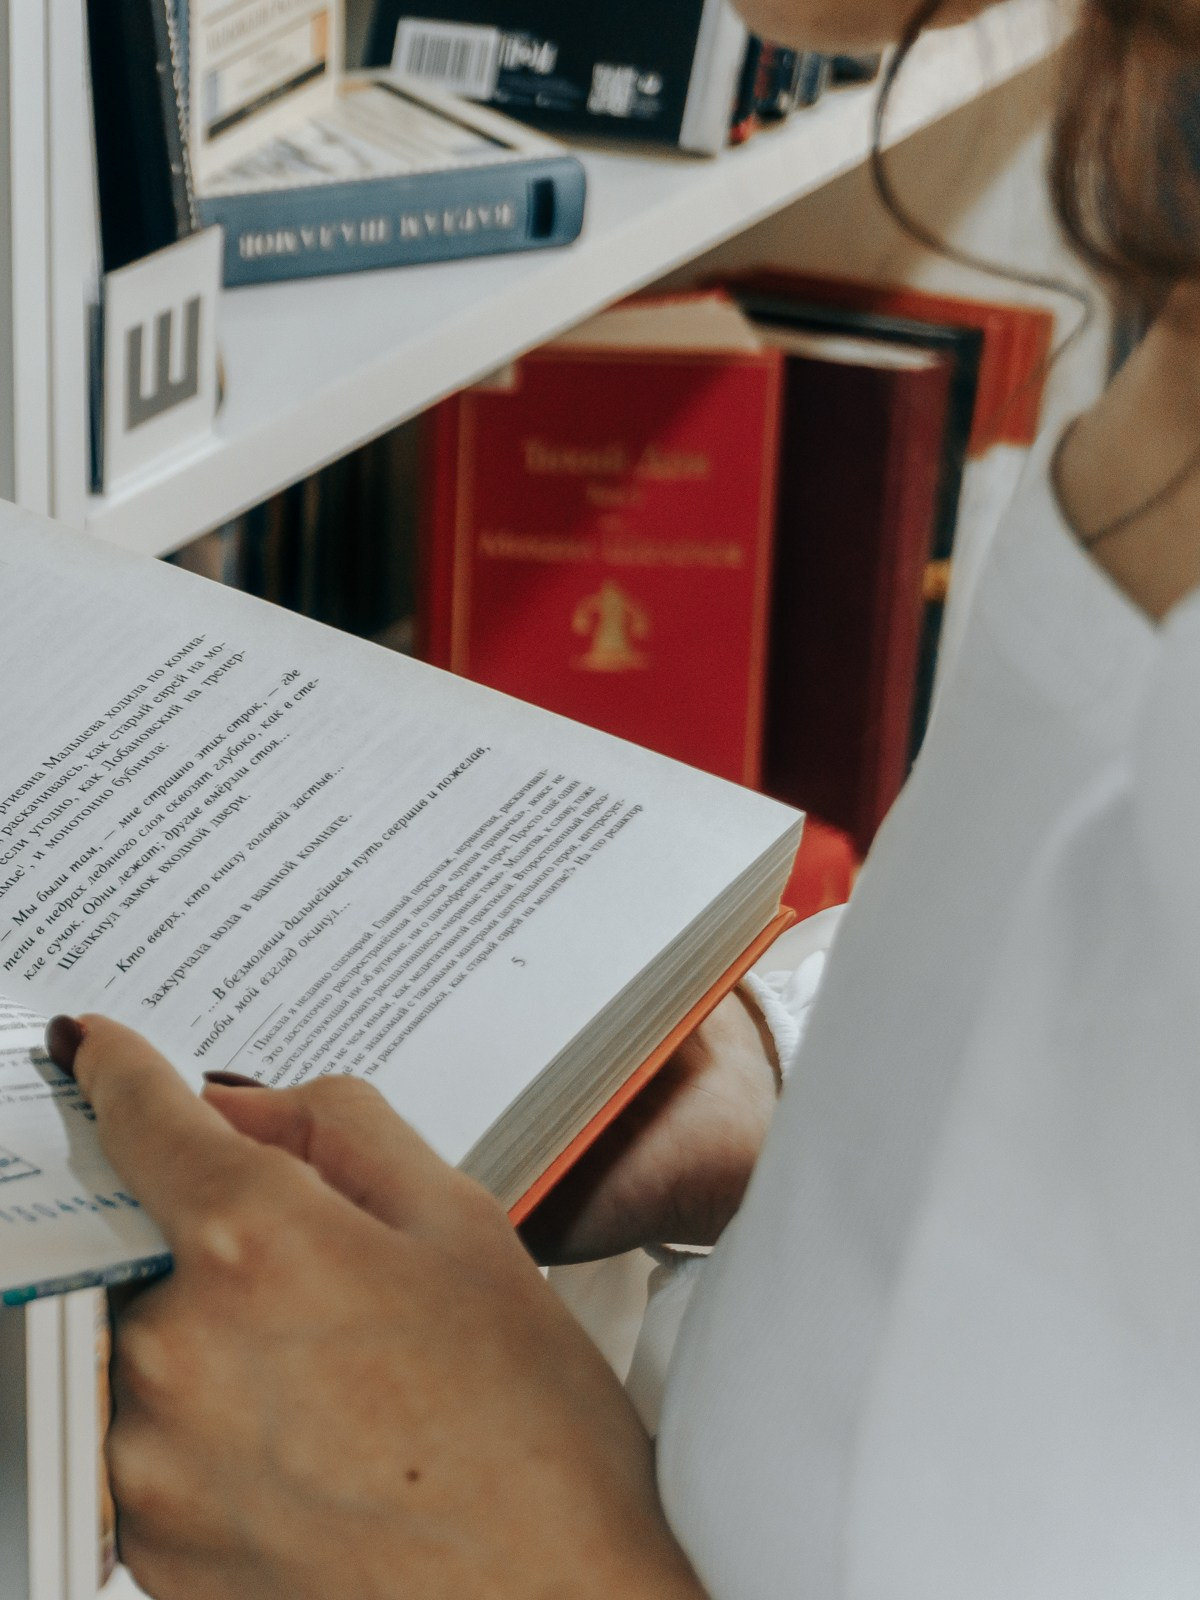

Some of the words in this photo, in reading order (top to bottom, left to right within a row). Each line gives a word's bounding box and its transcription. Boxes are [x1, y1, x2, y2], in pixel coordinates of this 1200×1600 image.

[0, 764, 89, 837] раскачиваясь,
[84, 741, 111, 761] как
[109, 703, 154, 740] старый
[152, 674, 189, 703] еврей
[186, 660, 206, 674] на
[203, 642, 226, 660] мо-
[11, 903, 38, 927] Мы
[36, 873, 69, 903] были
[68, 846, 104, 873] там,
[118, 806, 142, 829] мне
[142, 761, 195, 806] страшно
[194, 733, 227, 760] этих
[226, 702, 268, 733] строк,
[281, 669, 301, 686] где
[28, 797, 80, 838] угодно,
[77, 773, 105, 793] как
[100, 704, 184, 772] Лобановский
[182, 689, 203, 703] на
[200, 650, 246, 686] тренер-
[41, 720, 107, 770] Мальцева
[104, 684, 149, 719] ходила
[146, 669, 165, 683] по
[163, 634, 206, 668] комна-
[44, 789, 114, 849] монотонно
[111, 742, 170, 787] бубнила:
[2, 936, 36, 972] тени
[44, 884, 88, 925] недрах
[87, 838, 138, 886] ледяного
[138, 813, 166, 837] слоя
[165, 771, 214, 813] сквозят
[212, 732, 263, 771] глубоко,
[259, 709, 284, 730] как
[293, 678, 319, 701] сте-
[23, 957, 46, 981] кле
[46, 920, 85, 955] сучок.
[82, 885, 118, 915] Одни
[117, 841, 166, 886] лежат;
[161, 806, 204, 841] другие
[203, 766, 250, 806] вмёрзли
[56, 911, 121, 971] Щёлкнул
[118, 874, 160, 910] замок
[157, 827, 212, 874] входной
[209, 795, 252, 828] двери.
[115, 946, 146, 974] Кто
[146, 911, 186, 944] вверх,
[183, 883, 211, 908] кто
[210, 851, 246, 883] книзу
[245, 810, 291, 851] головой
[141, 943, 212, 1009] Зажурчала
[209, 914, 242, 941] вода
[250, 860, 299, 902] ванной
[296, 814, 353, 860] комнате.
[223, 930, 286, 989] безмолвии
[280, 867, 354, 931] дальнейшем
[351, 841, 384, 868] путь
[381, 799, 429, 841] свершив
[435, 747, 492, 791] пожелав,
[253, 1015, 290, 1051] Писала
[294, 972, 333, 1008] недавно
[330, 932, 376, 972] сценарий.
[371, 895, 413, 929] Главный
[410, 857, 457, 896] персонаж,
[453, 814, 503, 856] нервничая,
[498, 769, 549, 814] раскачивал-
[283, 994, 333, 1045] достаточно
[332, 918, 411, 994] распространённая
[410, 883, 448, 918] людская
[527, 785, 554, 807] вовсе
[310, 996, 377, 1062] нормализовать
[373, 930, 443, 997] расшалившиеся
[502, 834, 548, 869] Молитва,
[549, 805, 578, 827] слову,
[572, 786, 596, 805] тоже
[363, 1002, 396, 1029] иным,
[408, 926, 470, 983] медитативной
[467, 883, 517, 926] практикой.
[512, 817, 585, 881] Второстепенный
[581, 793, 609, 818] персо-
[364, 1007, 409, 1052] знакомый
[412, 959, 458, 1000] таковыми
[455, 919, 500, 959] манерами
[497, 866, 555, 919] центрального
[552, 844, 582, 867] героя,
[577, 799, 625, 842] интересует-
[371, 942, 411, 975] аутизме,
[426, 871, 484, 922] шизофрении
[487, 845, 513, 865] проч.
[507, 814, 544, 843] Просто
[557, 780, 582, 800] один
[193, 1014, 235, 1057] чтобы
[234, 986, 260, 1014] мой
[260, 947, 298, 986] взгляд
[377, 991, 453, 1063] раскачиваешься,
[465, 941, 499, 972] старый
[497, 918, 524, 942] еврей
[603, 804, 644, 840] редактор
[511, 957, 527, 969] 5
